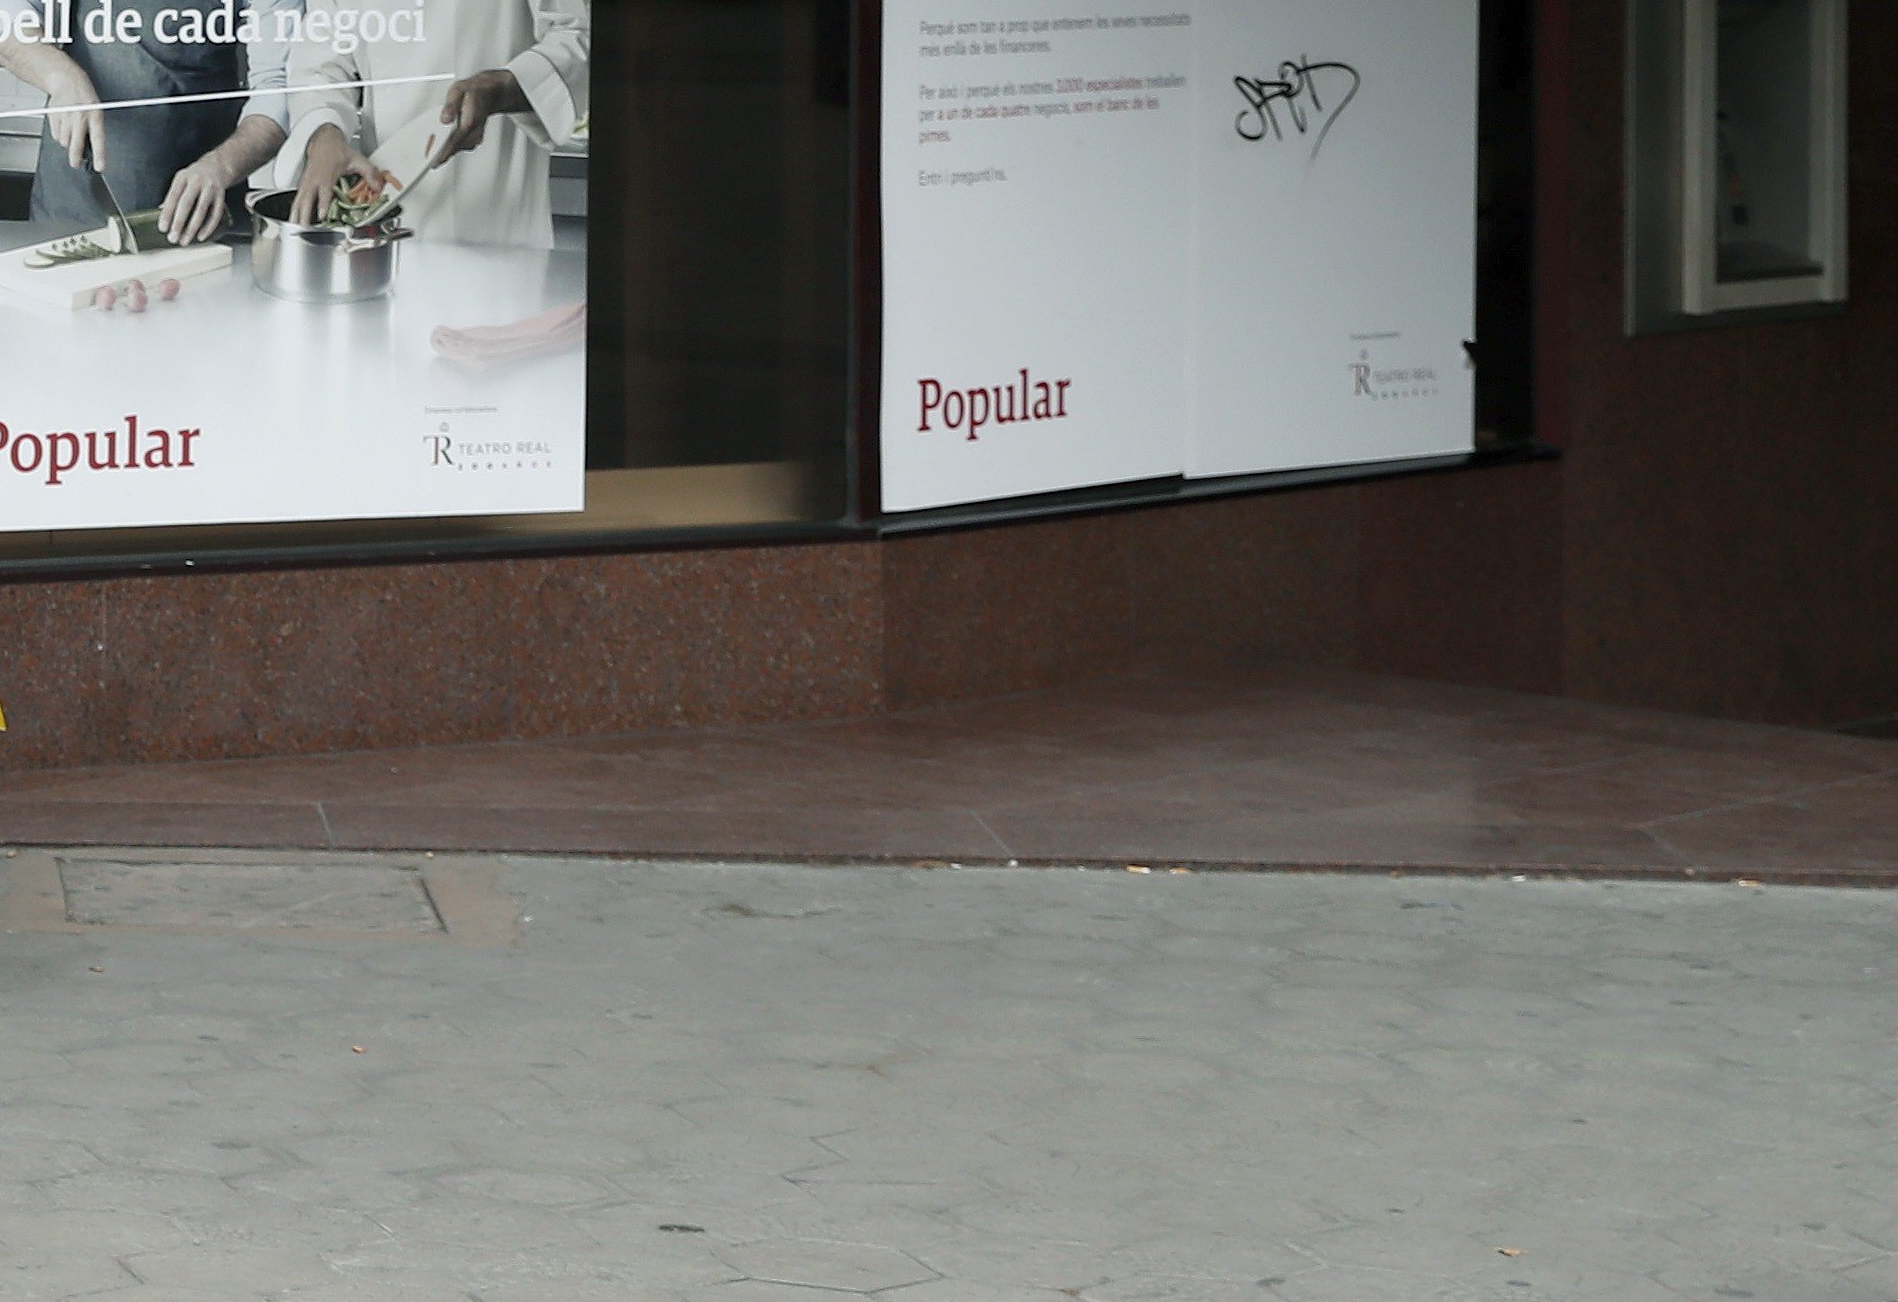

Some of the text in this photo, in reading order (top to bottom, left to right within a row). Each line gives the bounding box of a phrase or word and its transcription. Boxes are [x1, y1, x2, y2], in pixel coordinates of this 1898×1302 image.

[917, 368, 1071, 441] Popular
[458, 441, 552, 456] TEATRO REAL
